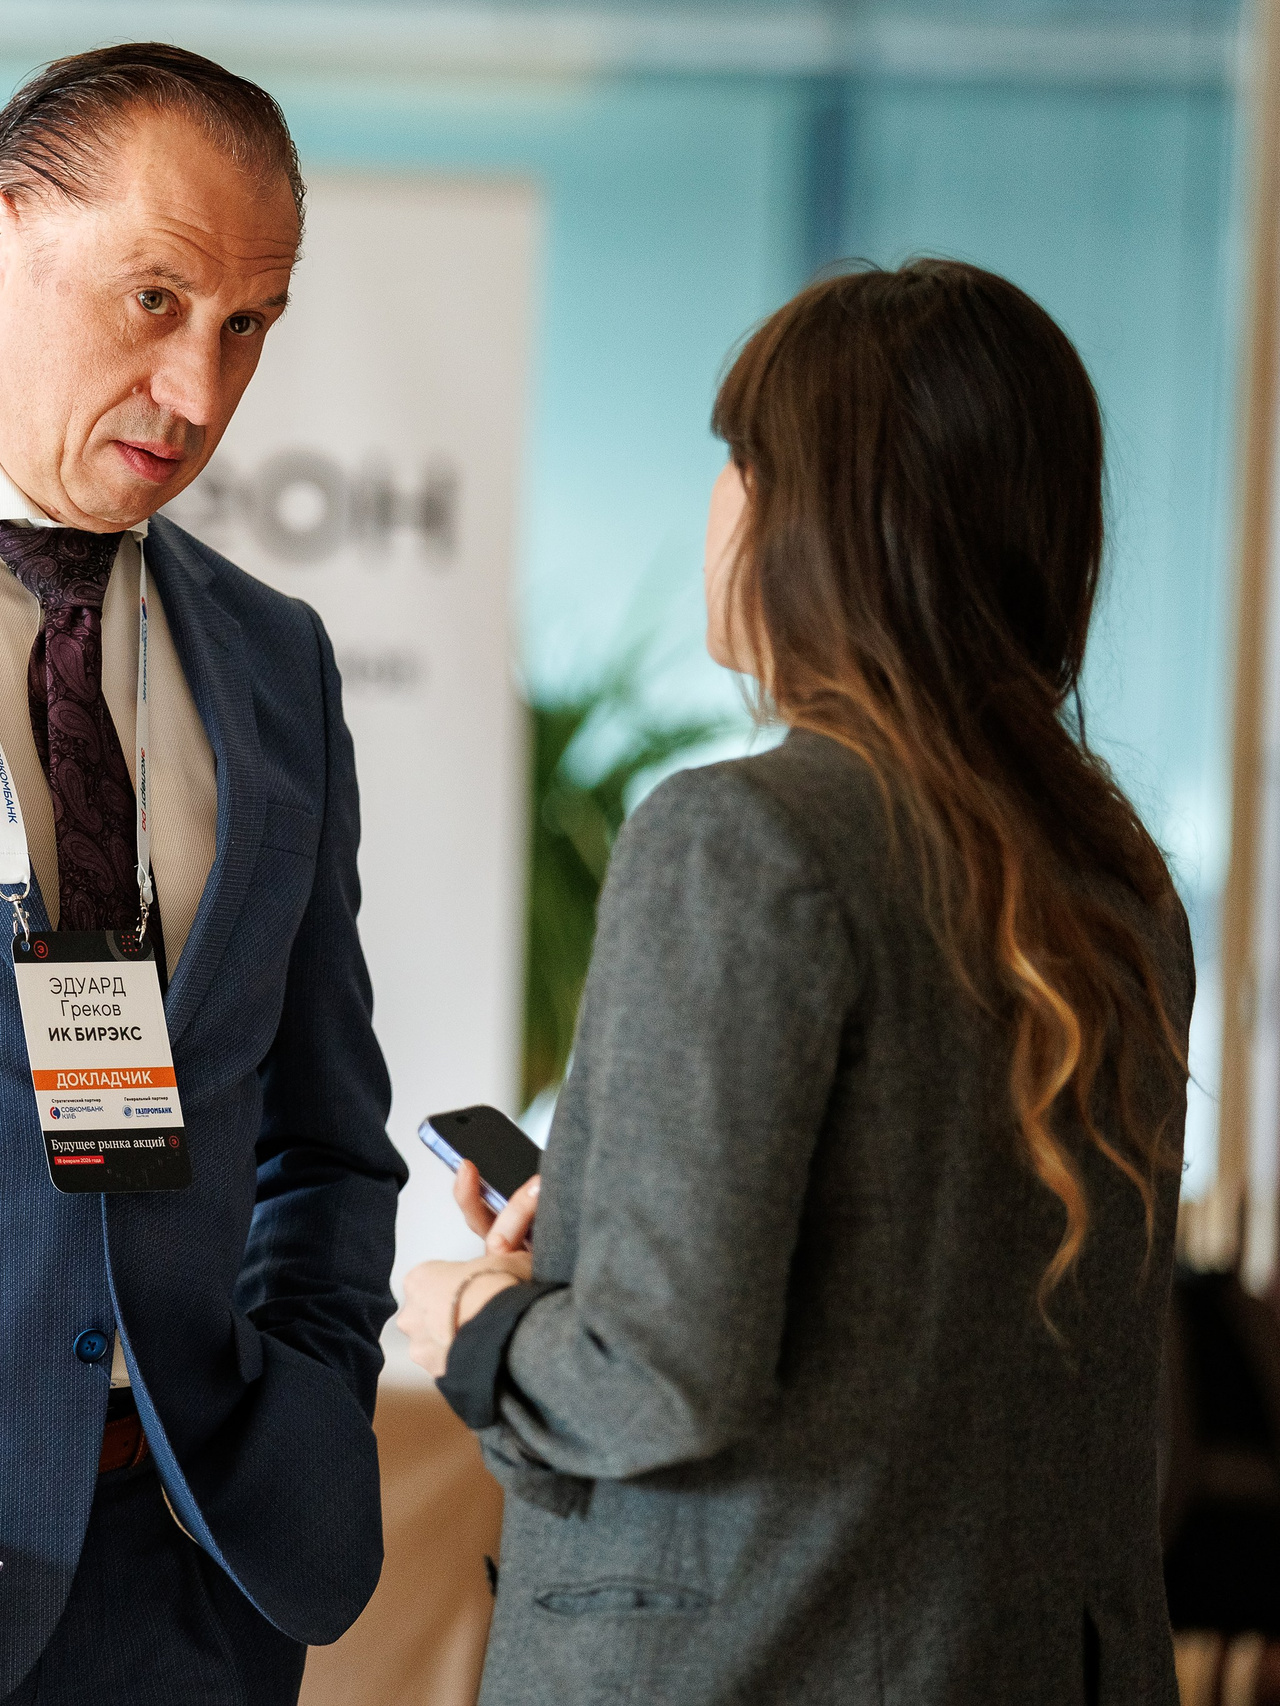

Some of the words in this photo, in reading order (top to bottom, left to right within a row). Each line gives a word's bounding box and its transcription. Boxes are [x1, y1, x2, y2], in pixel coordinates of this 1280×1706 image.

[49, 977, 126, 997] ЭДУАРД
[61, 1000, 122, 1021] Греков
[48, 1027, 72, 1041] ИК
[75, 1026, 142, 1041] БИРЭКС
[56, 1070, 153, 1089] ДОКЛАДЧИК
[51, 1139, 95, 1153] Будущее
[98, 1139, 131, 1152] рынка
[133, 1136, 166, 1149] акций
